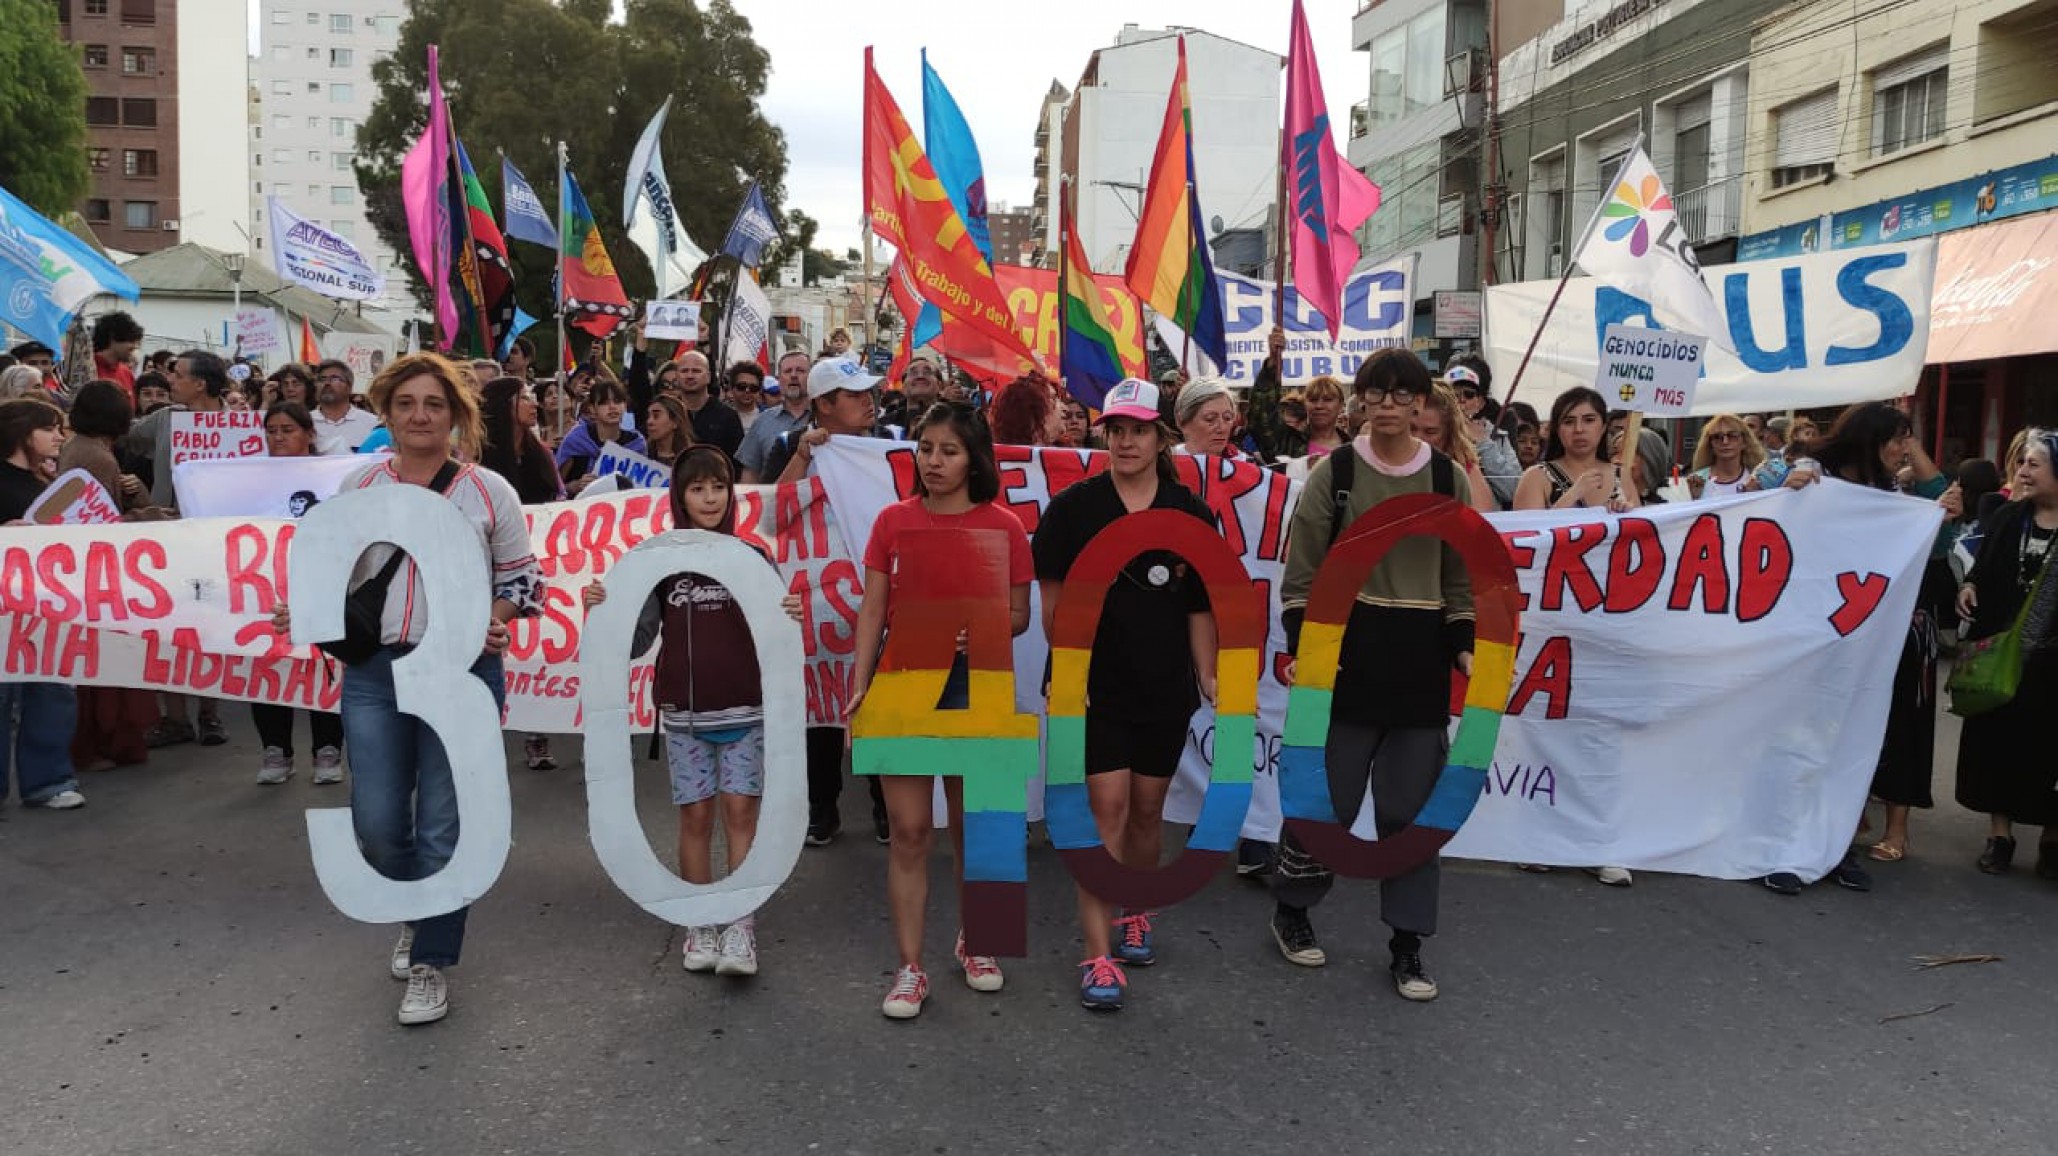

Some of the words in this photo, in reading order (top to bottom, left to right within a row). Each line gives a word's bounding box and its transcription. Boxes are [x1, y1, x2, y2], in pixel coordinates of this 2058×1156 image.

[915, 259, 971, 307] Trabajo
[972, 299, 984, 315] y
[986, 305, 1008, 330] del
[173, 431, 220, 449] PABLO
[194, 412, 264, 429] FUERZA
[0, 539, 174, 621] OSAS
[1483, 759, 1556, 807] VIA
